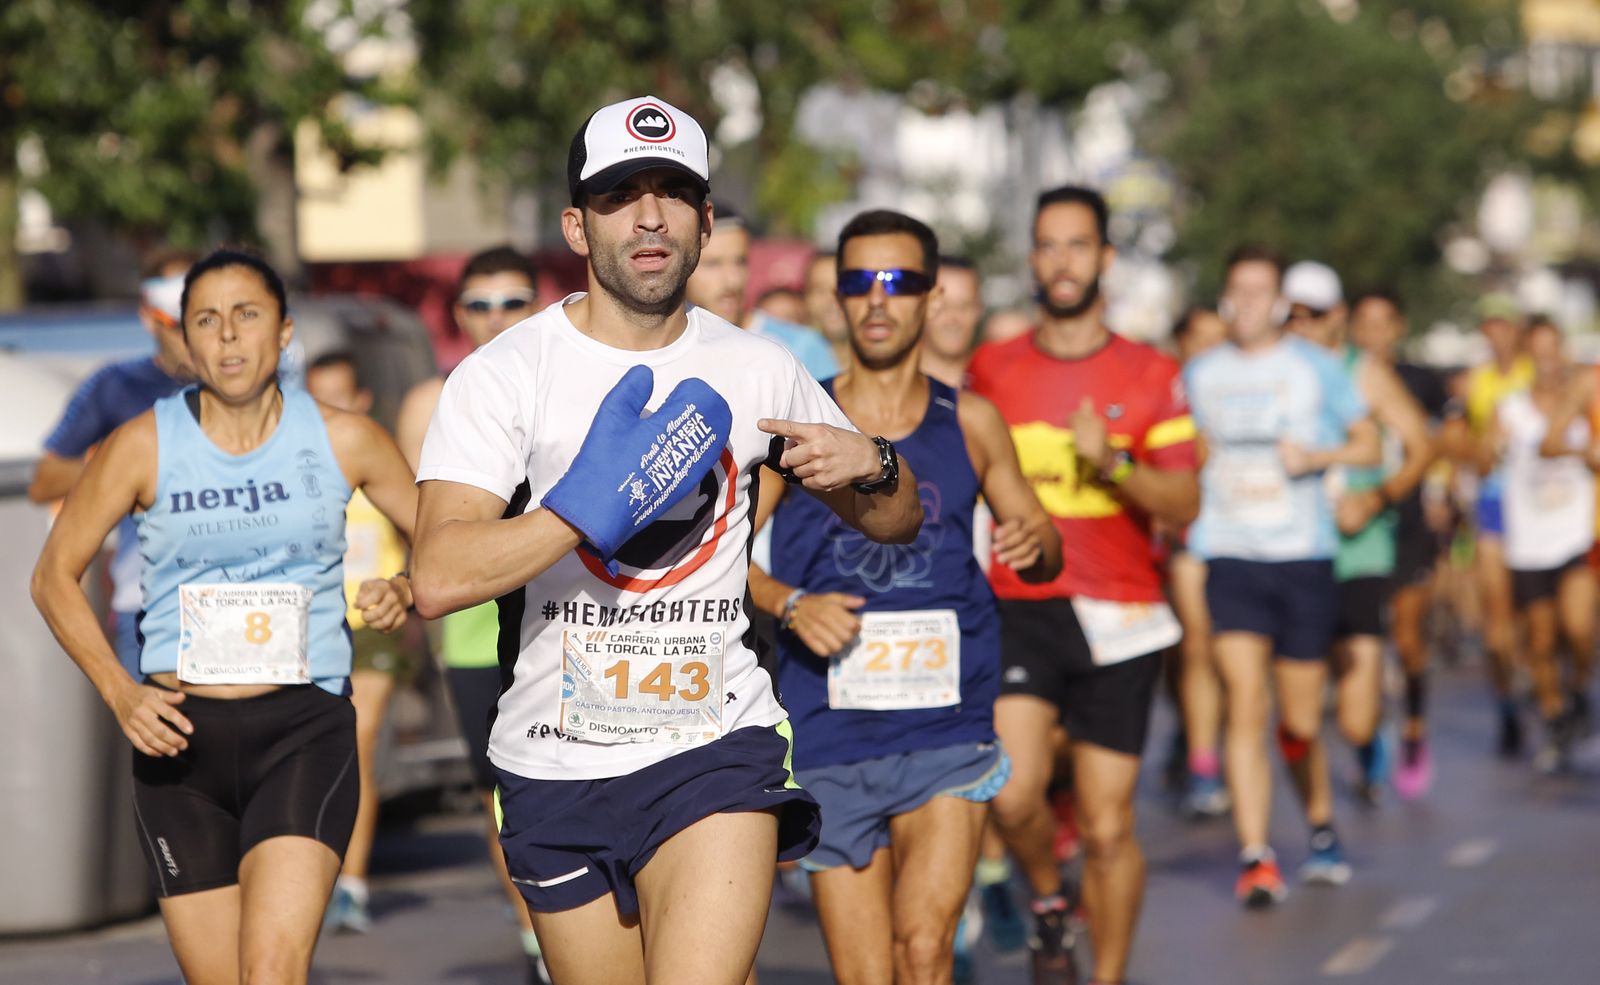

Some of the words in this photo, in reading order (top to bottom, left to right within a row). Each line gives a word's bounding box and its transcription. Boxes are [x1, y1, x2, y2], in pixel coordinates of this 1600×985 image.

[624, 145, 685, 158] #HEMIFIGHTERS
[666, 404, 696, 436] Manopla
[650, 421, 712, 492] INFANTIL
[652, 412, 704, 471] HEMIPARESIA
[170, 479, 290, 514] nerja
[186, 514, 278, 537] ATLETISMO
[244, 612, 272, 645] 8
[541, 598, 740, 628] #HEMIFIGHTERS
[586, 643, 601, 653] EL
[605, 644, 657, 656] TORCAL
[664, 646, 680, 656] LA
[684, 644, 706, 656] PAZ
[610, 634, 660, 644] CARRERA
[664, 636, 706, 645] URBANA
[864, 638, 948, 672] 273
[604, 660, 710, 702] 143
[575, 701, 606, 712] CASTRO
[641, 706, 676, 715] ANTONIO
[589, 722, 658, 735] DISMOAUTO
